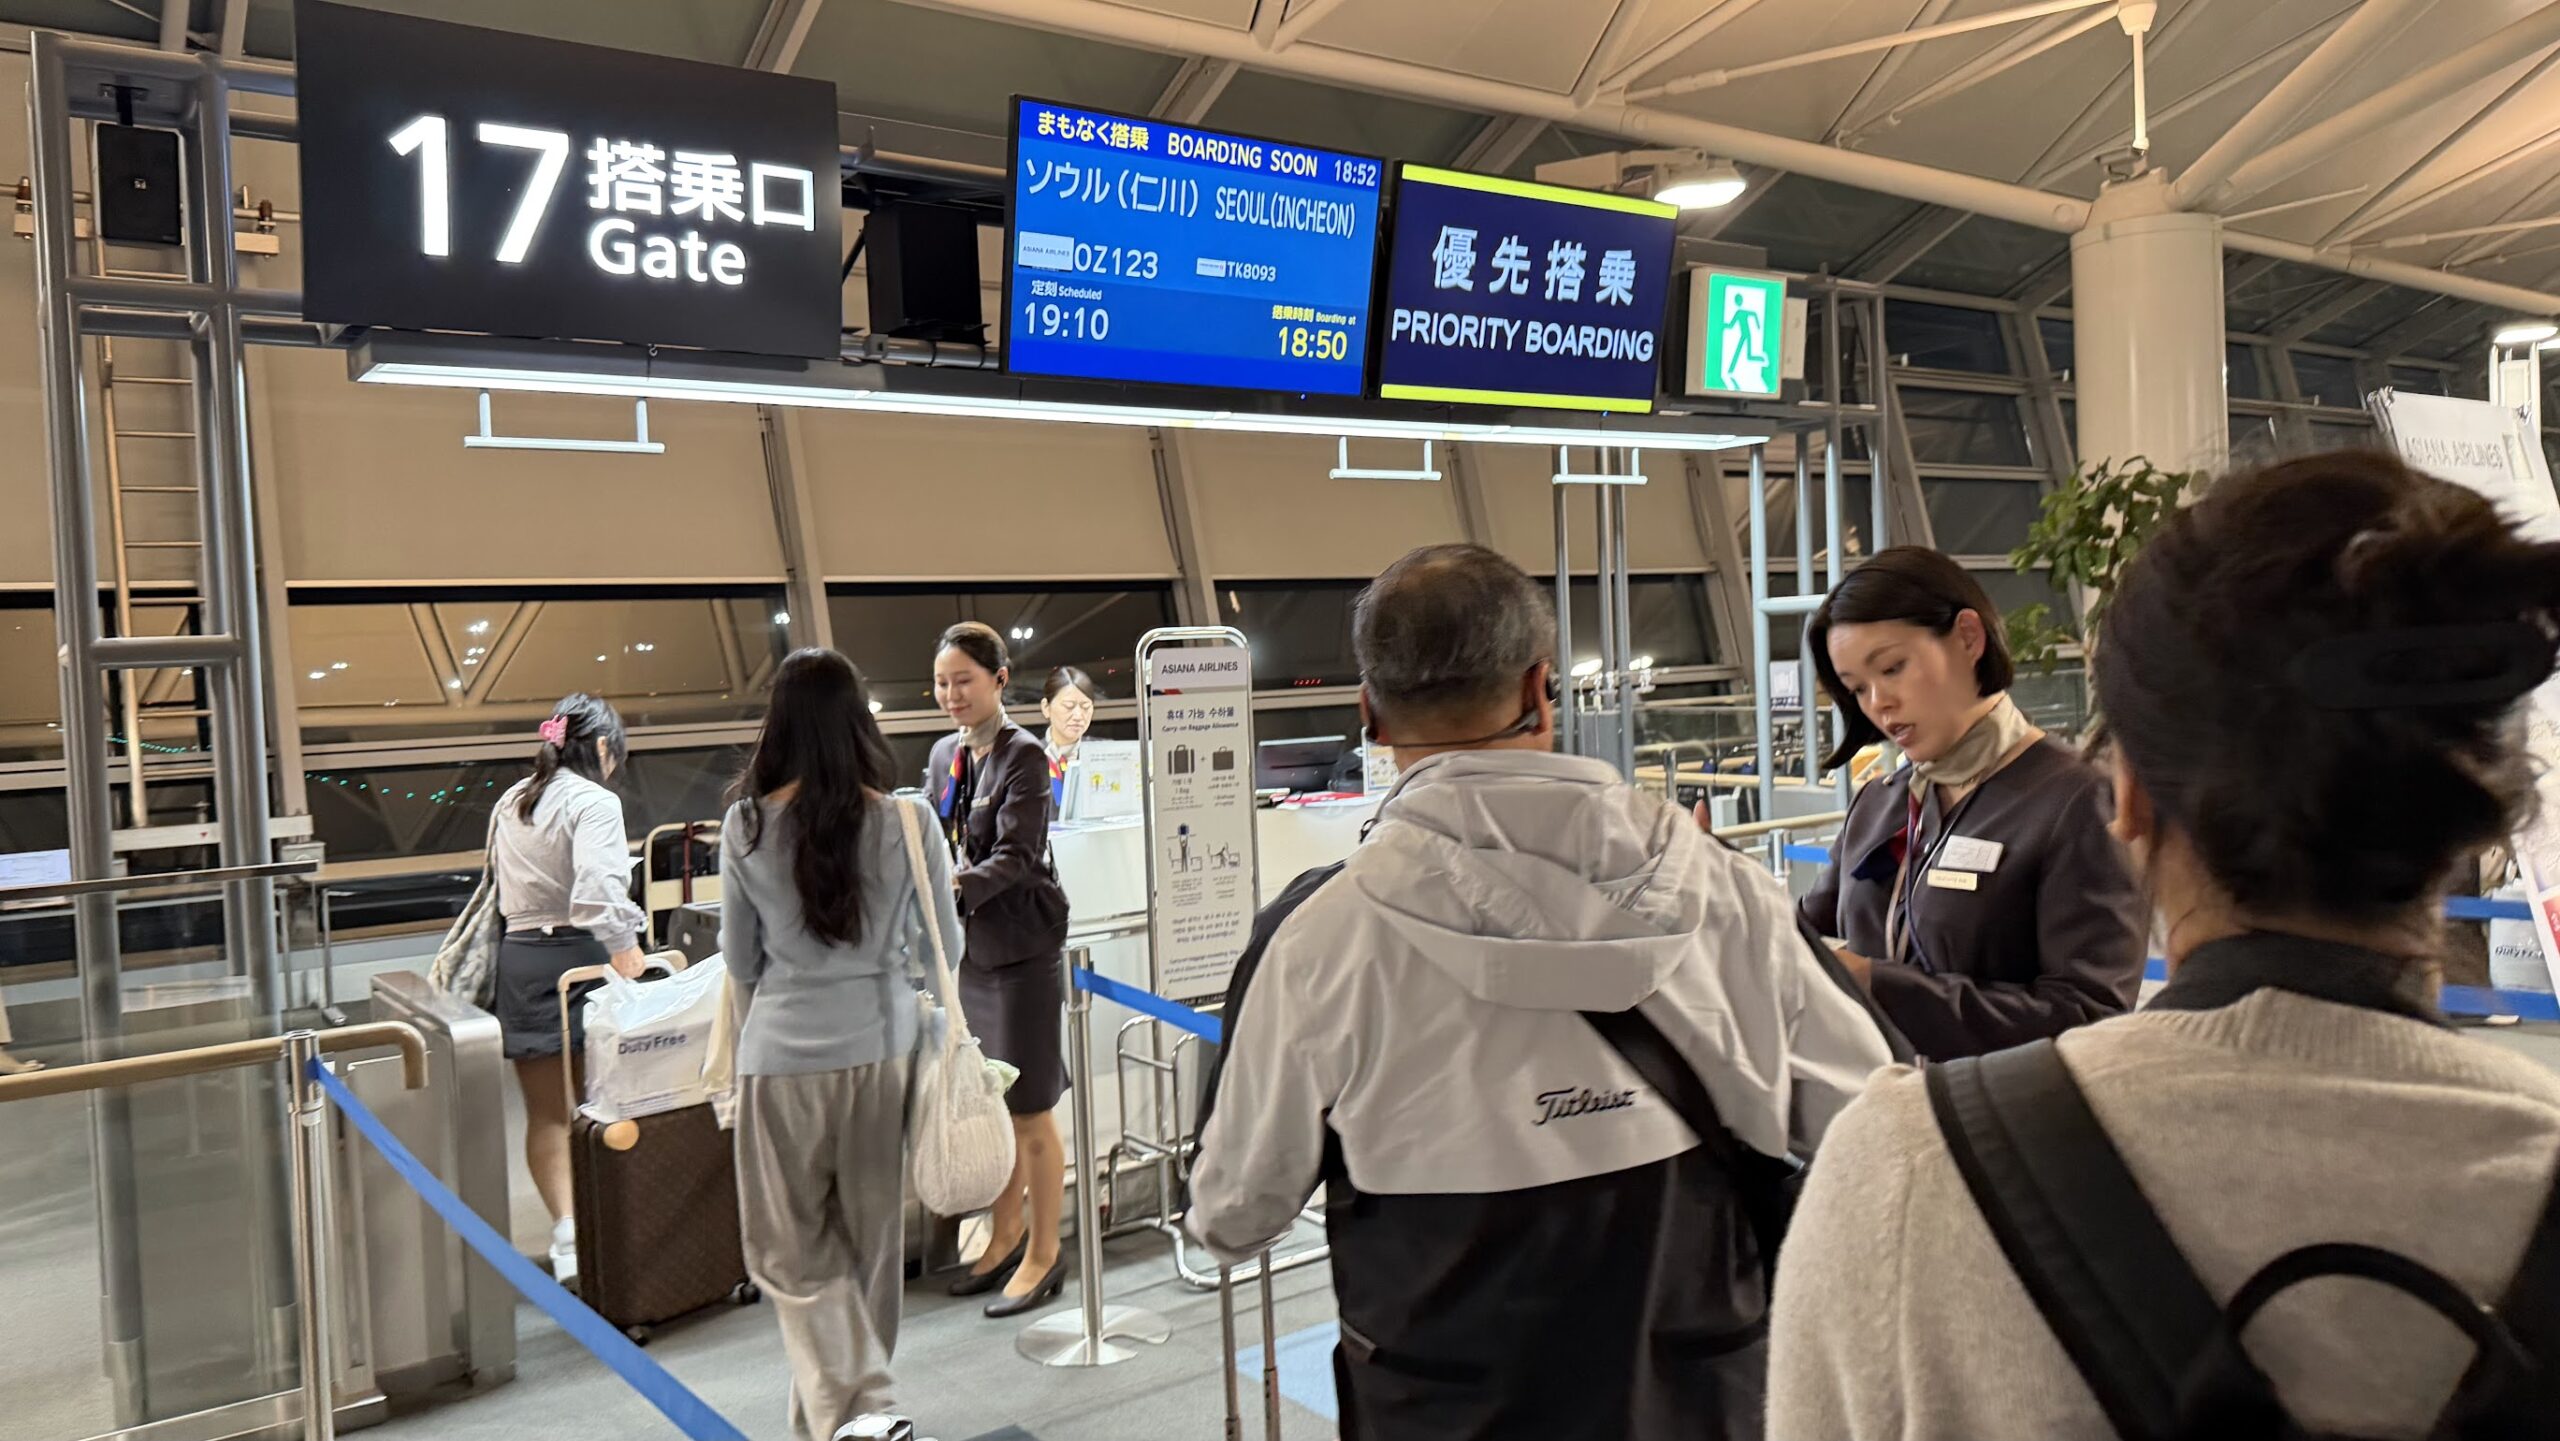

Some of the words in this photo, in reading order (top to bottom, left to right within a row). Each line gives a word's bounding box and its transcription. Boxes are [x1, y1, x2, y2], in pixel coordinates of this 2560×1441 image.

[1037, 111, 1149, 152] まもなく搭乗
[1168, 132, 1262, 168] BOARDING
[1270, 149, 1318, 178] SOON
[1333, 159, 1377, 187] 18:52
[388, 115, 570, 264] 17
[586, 137, 815, 232] 搭乗口
[1215, 185, 1355, 239] SEOUL(INCHEON)
[587, 218, 747, 286] Gate
[1073, 243, 1159, 279] OZ123
[1227, 261, 1277, 282] TK8093
[1432, 225, 1637, 306] 優先搭乗
[1031, 279, 1058, 297] 定刻
[1058, 285, 1102, 300] Scheduled
[1024, 302, 1109, 341] 19:10
[1315, 311, 1347, 326] Boarding
[1348, 315, 1357, 326] at
[1391, 308, 1521, 351] PRIORITY
[1524, 320, 1654, 362] BOARDING
[1278, 326, 1348, 361] 18:50
[1162, 664, 1195, 674] ASIANA
[1198, 661, 1238, 672] AIRLINES
[618, 1041, 650, 1054] Duty
[654, 1034, 687, 1048] Free
[1531, 1086, 1637, 1126] Titleist
